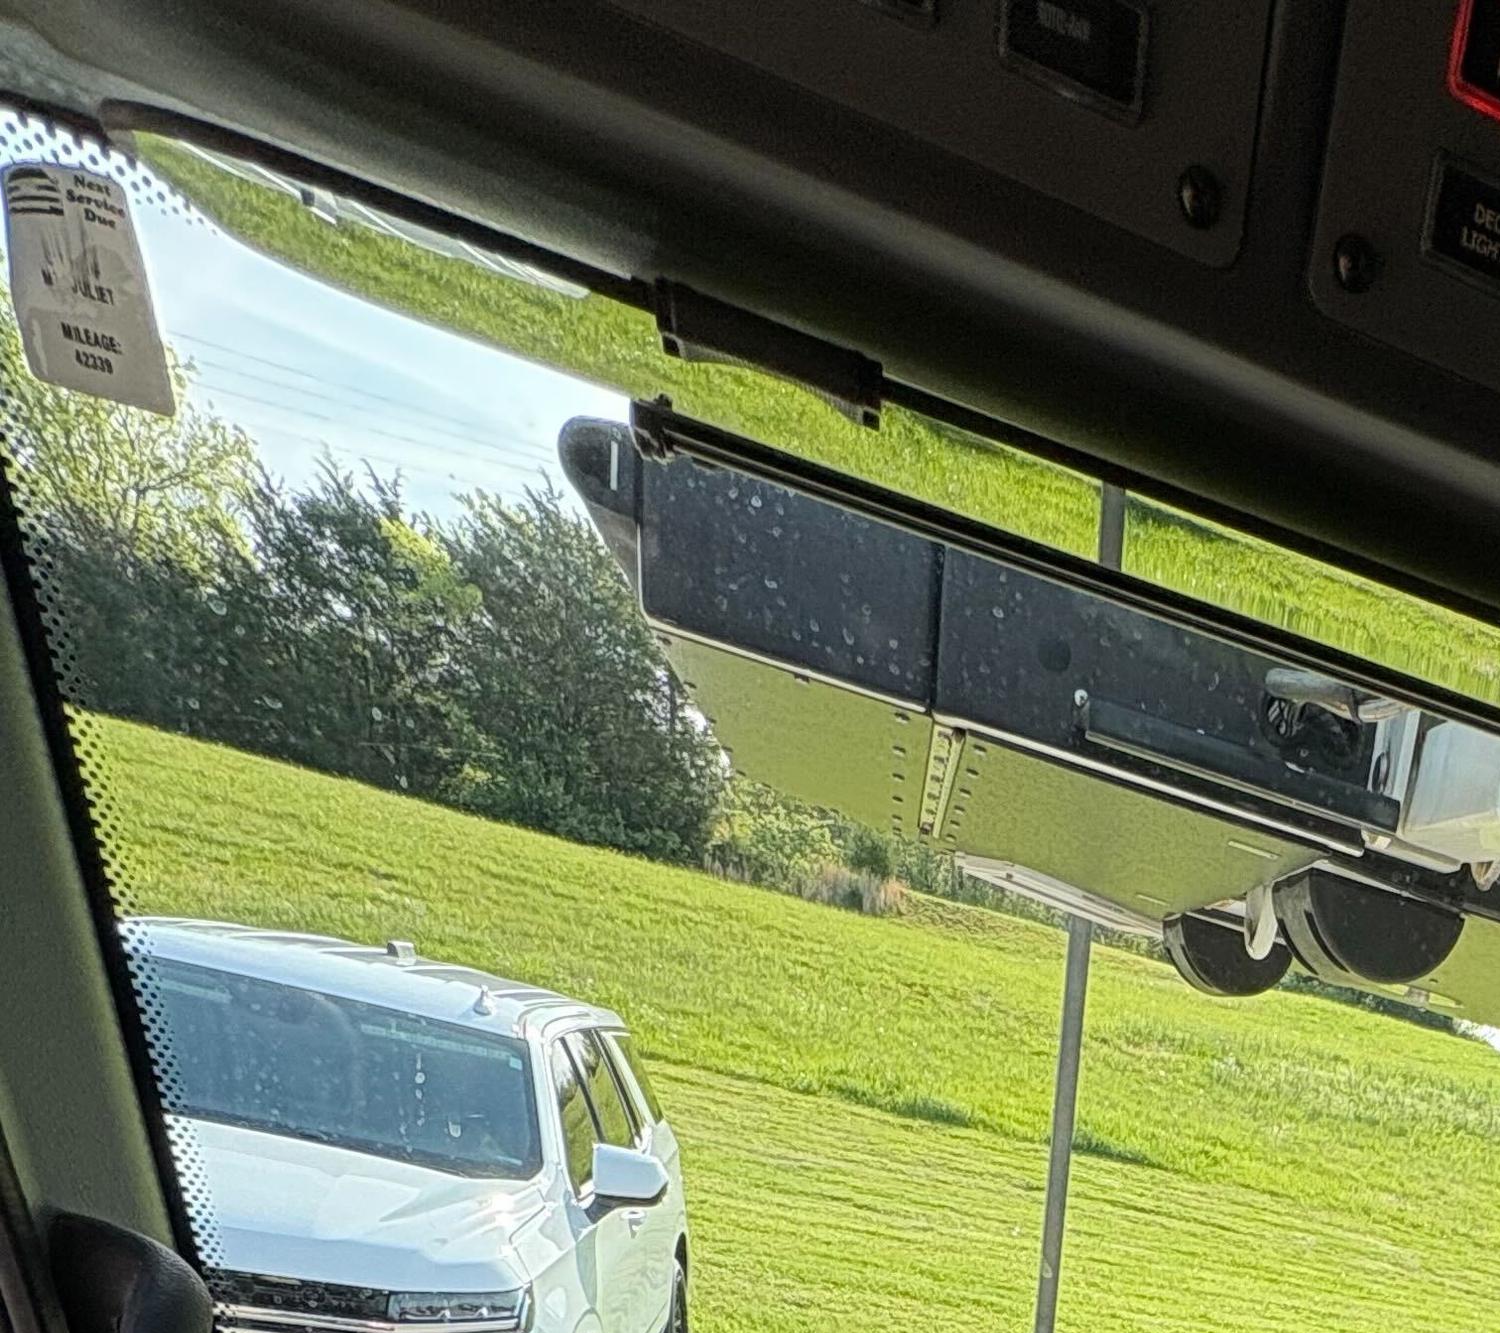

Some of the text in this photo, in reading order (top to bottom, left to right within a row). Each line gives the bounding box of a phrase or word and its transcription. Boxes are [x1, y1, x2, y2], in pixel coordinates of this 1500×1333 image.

[73, 174, 111, 197] Next
[65, 188, 126, 219] Service
[84, 207, 117, 230] Due
